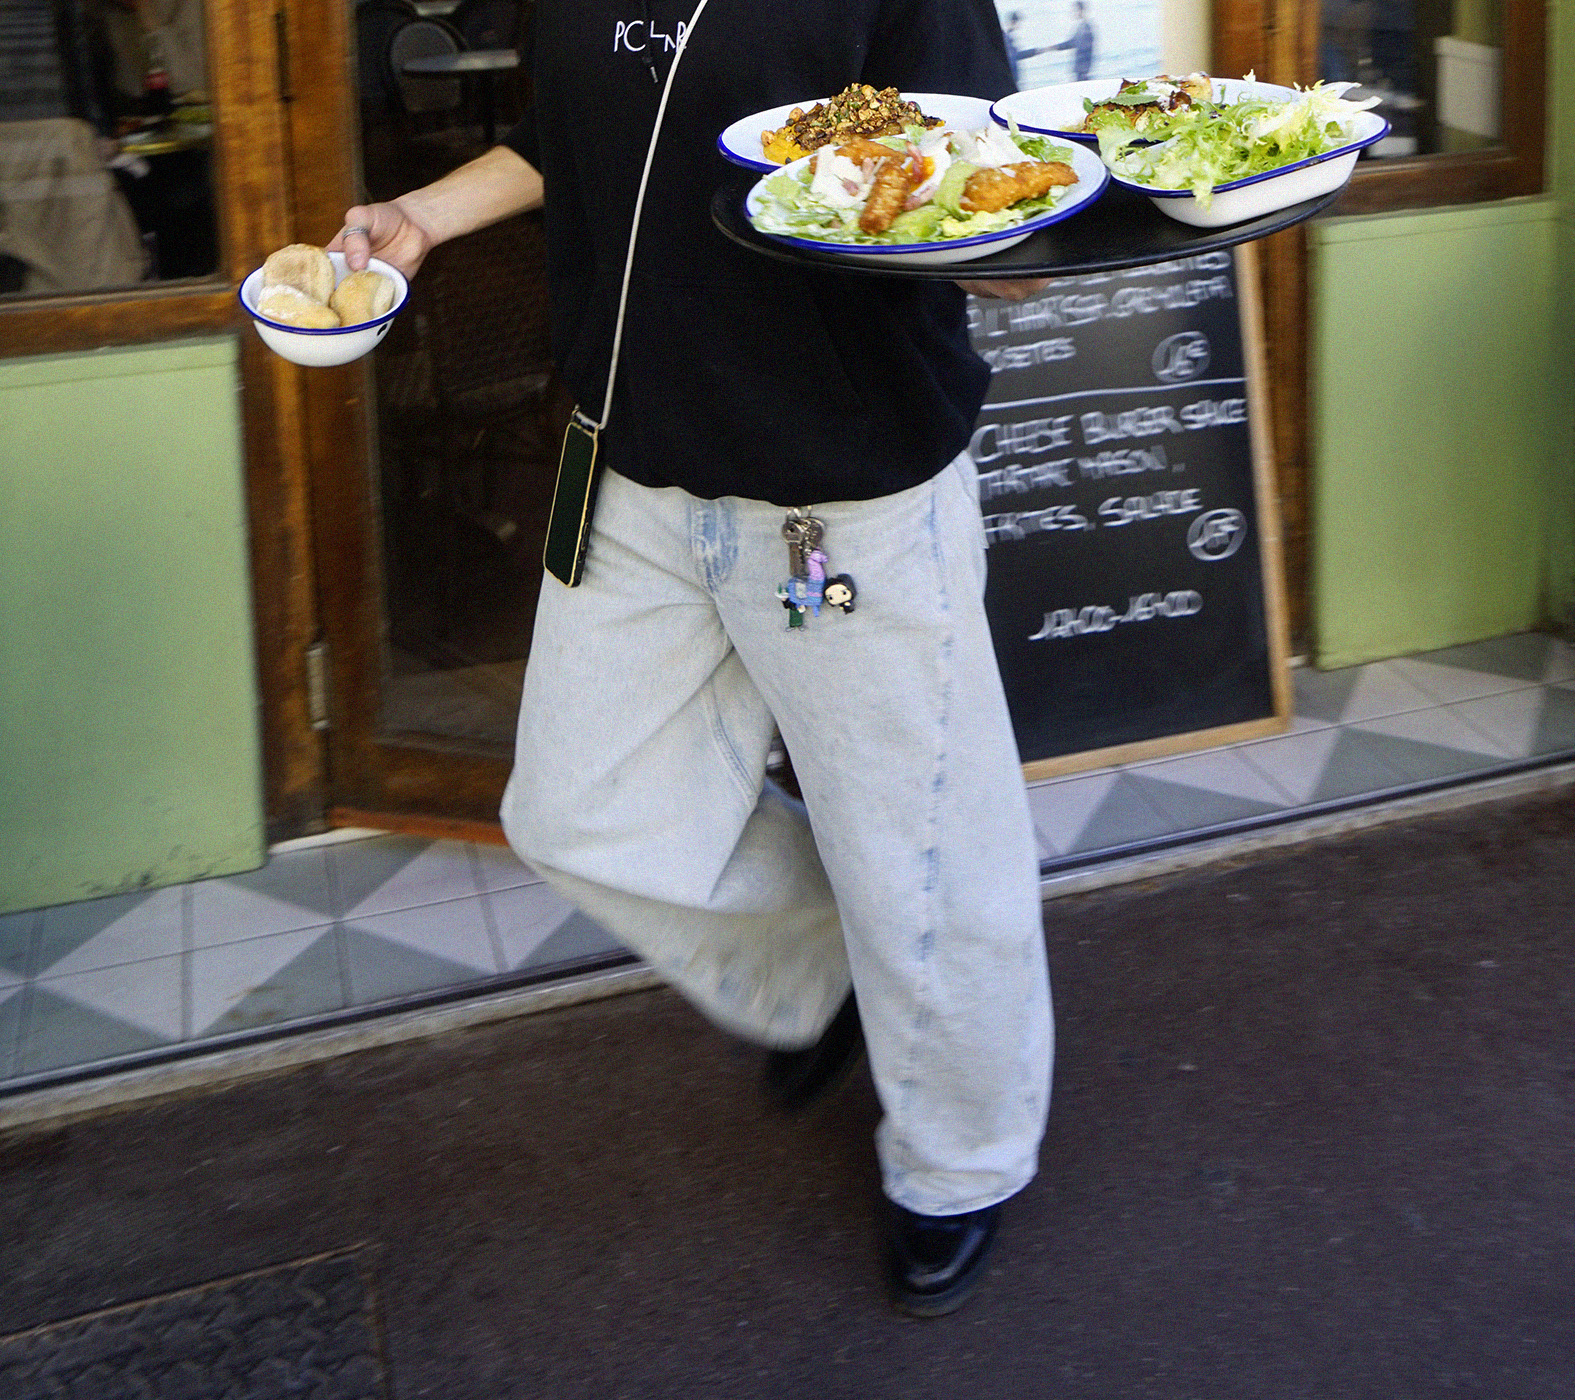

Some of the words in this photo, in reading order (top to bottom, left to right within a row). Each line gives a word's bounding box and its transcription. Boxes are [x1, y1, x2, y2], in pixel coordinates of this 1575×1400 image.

[970, 414, 1075, 463] CHEESE
[1080, 406, 1184, 445] BURGER
[1098, 488, 1204, 528] SALADE
